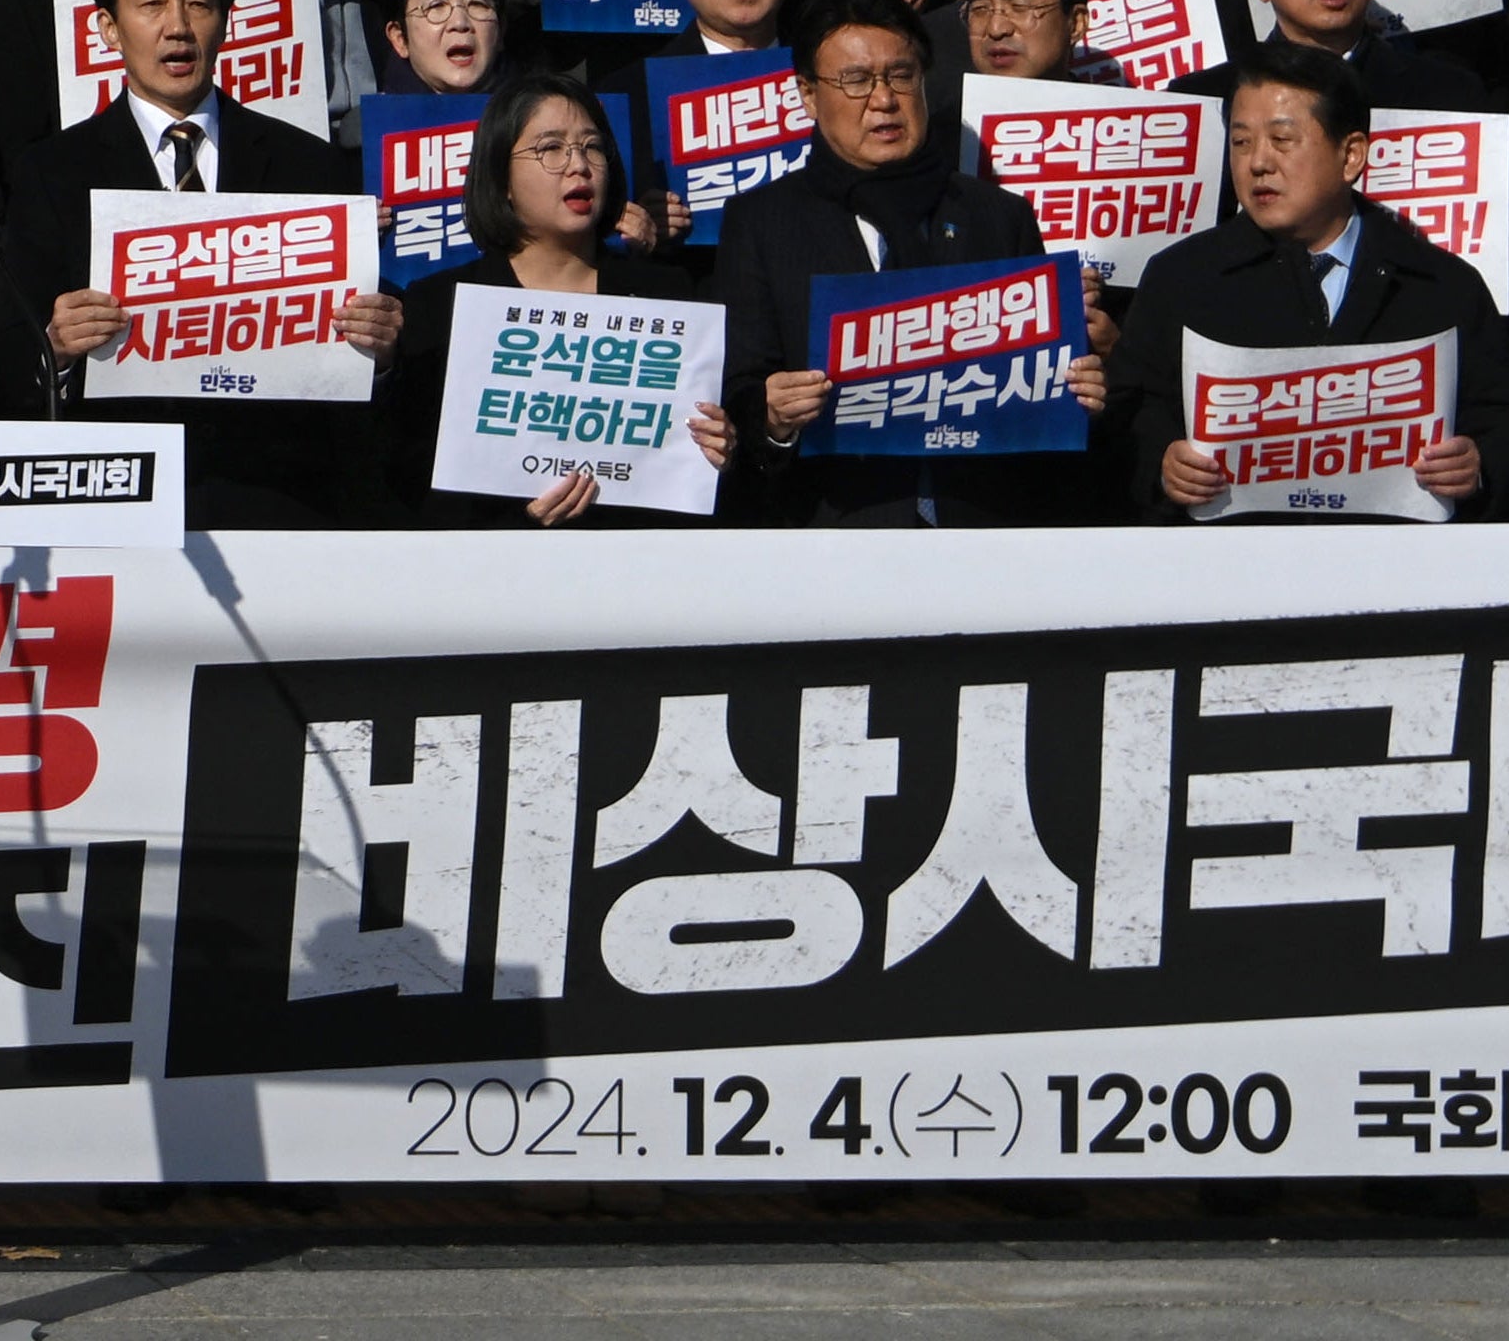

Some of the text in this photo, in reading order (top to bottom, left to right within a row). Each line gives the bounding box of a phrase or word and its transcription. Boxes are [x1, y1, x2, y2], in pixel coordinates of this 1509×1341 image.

[990, 112, 1188, 176] 윤석열은
[124, 214, 334, 298] 윤석열은
[116, 287, 374, 365] 사퇴하라!
[491, 327, 682, 390] 윤석열을
[506, 307, 686, 337] 불법계엄 내란음모
[839, 274, 1050, 372] 내란행위
[476, 387, 672, 449] 탄핵하라
[834, 344, 1091, 429] 즉각수사!
[1204, 358, 1423, 435] 윤석열은
[406, 1076, 648, 1159] 2024.
[673, 1076, 783, 1157] 12.
[809, 1071, 1023, 1159] 4.(수)
[1048, 1071, 1292, 1158] 12:00
